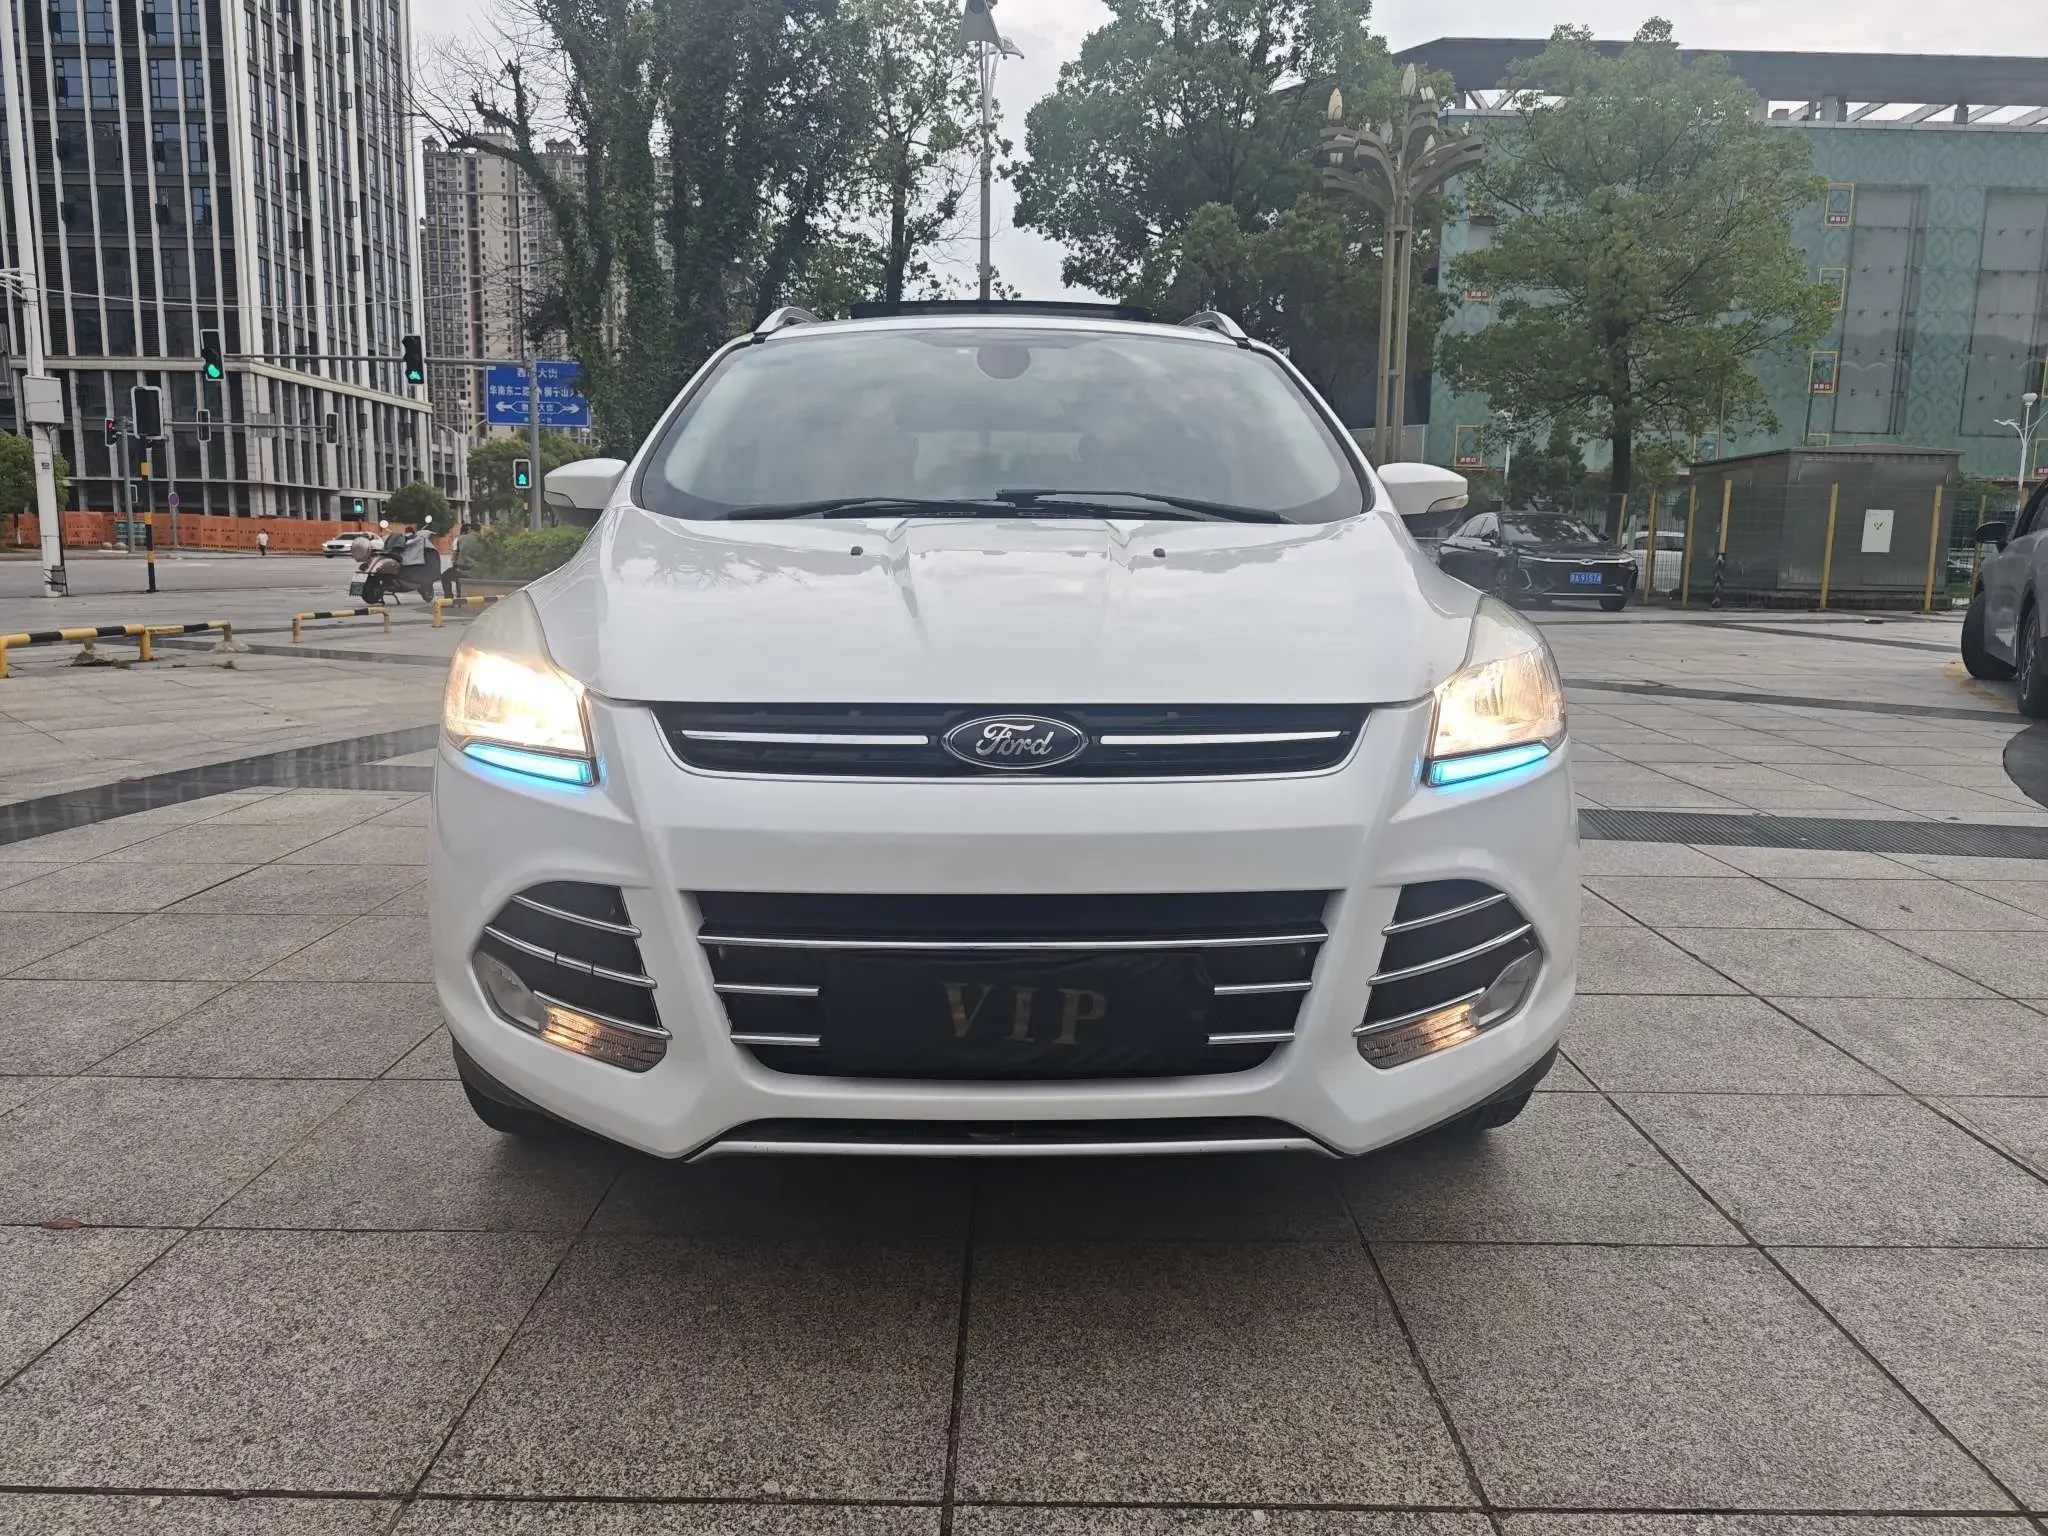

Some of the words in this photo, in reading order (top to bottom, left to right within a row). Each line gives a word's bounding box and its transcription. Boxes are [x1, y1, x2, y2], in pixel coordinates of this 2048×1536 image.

[517, 368, 558, 378] 西大街
[975, 723, 1055, 756] Ford
[941, 981, 1108, 1045] VIP
